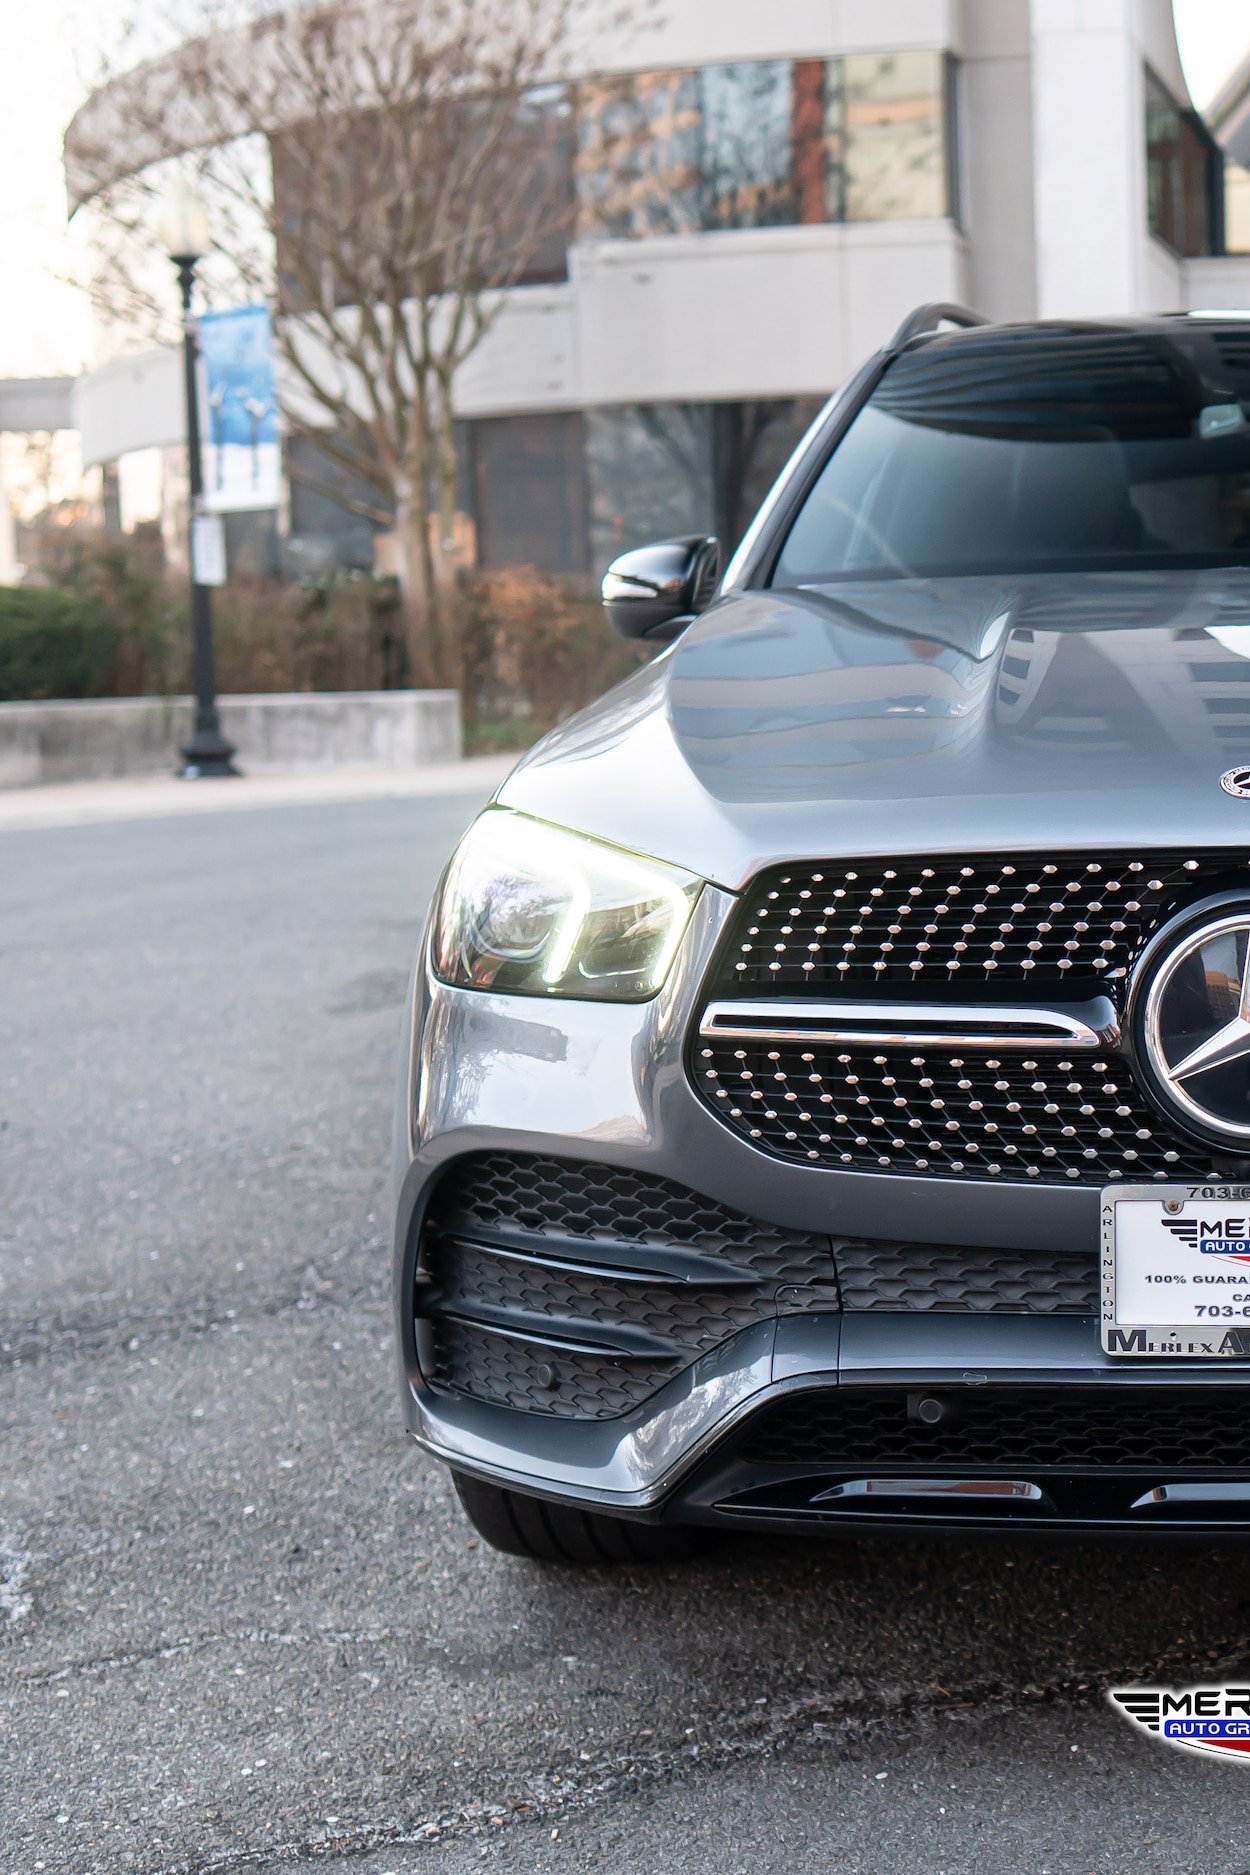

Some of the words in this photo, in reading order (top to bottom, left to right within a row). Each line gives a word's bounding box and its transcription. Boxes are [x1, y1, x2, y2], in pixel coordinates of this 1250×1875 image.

[1205, 1241, 1246, 1252] AUTO
[1103, 1205, 1113, 1321] ARLINGTON
[1145, 1275, 1187, 1285] 100%
